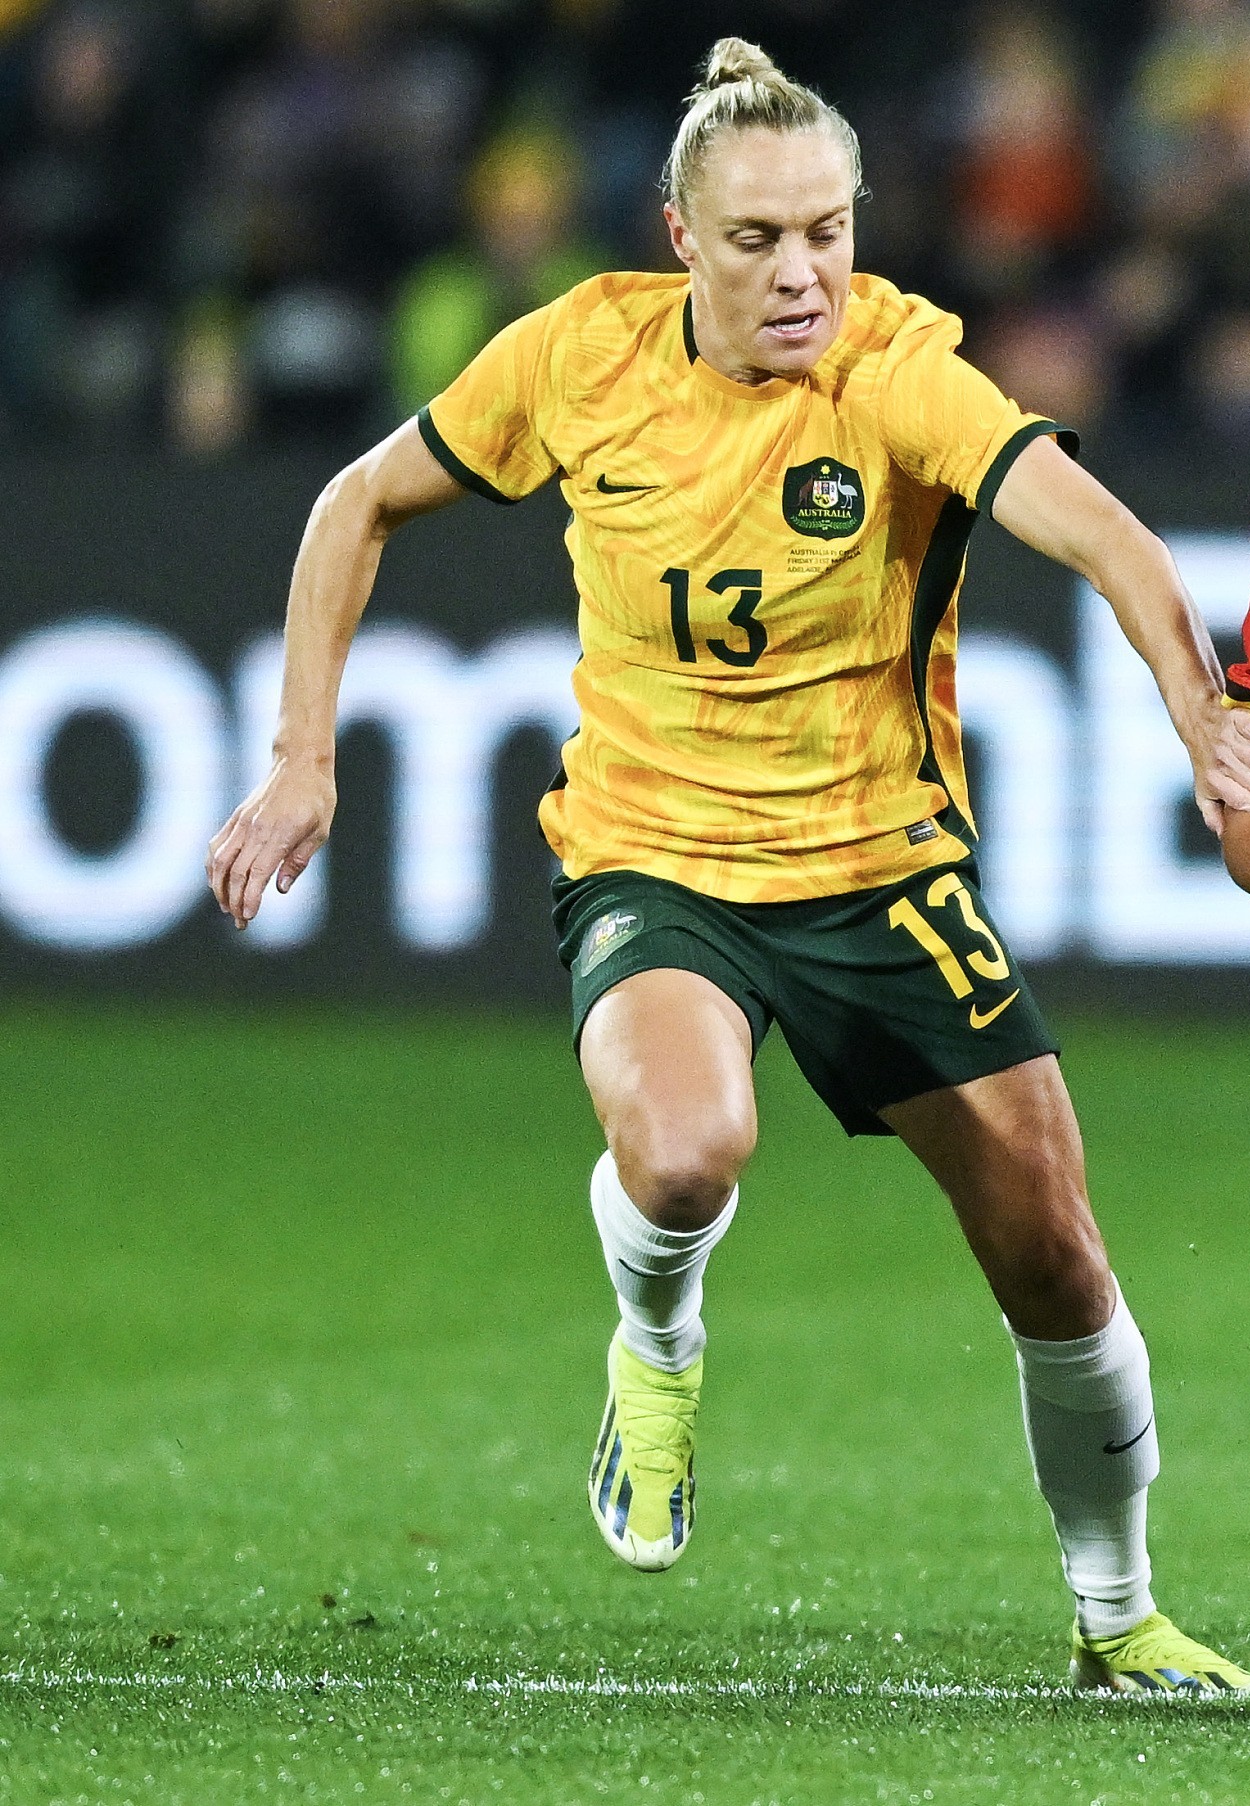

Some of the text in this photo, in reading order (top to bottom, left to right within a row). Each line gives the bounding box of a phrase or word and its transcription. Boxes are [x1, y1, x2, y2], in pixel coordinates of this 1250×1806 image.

[798, 508, 851, 518] AUSTRALIA
[659, 566, 768, 668] 13
[888, 871, 1010, 1000] 13
